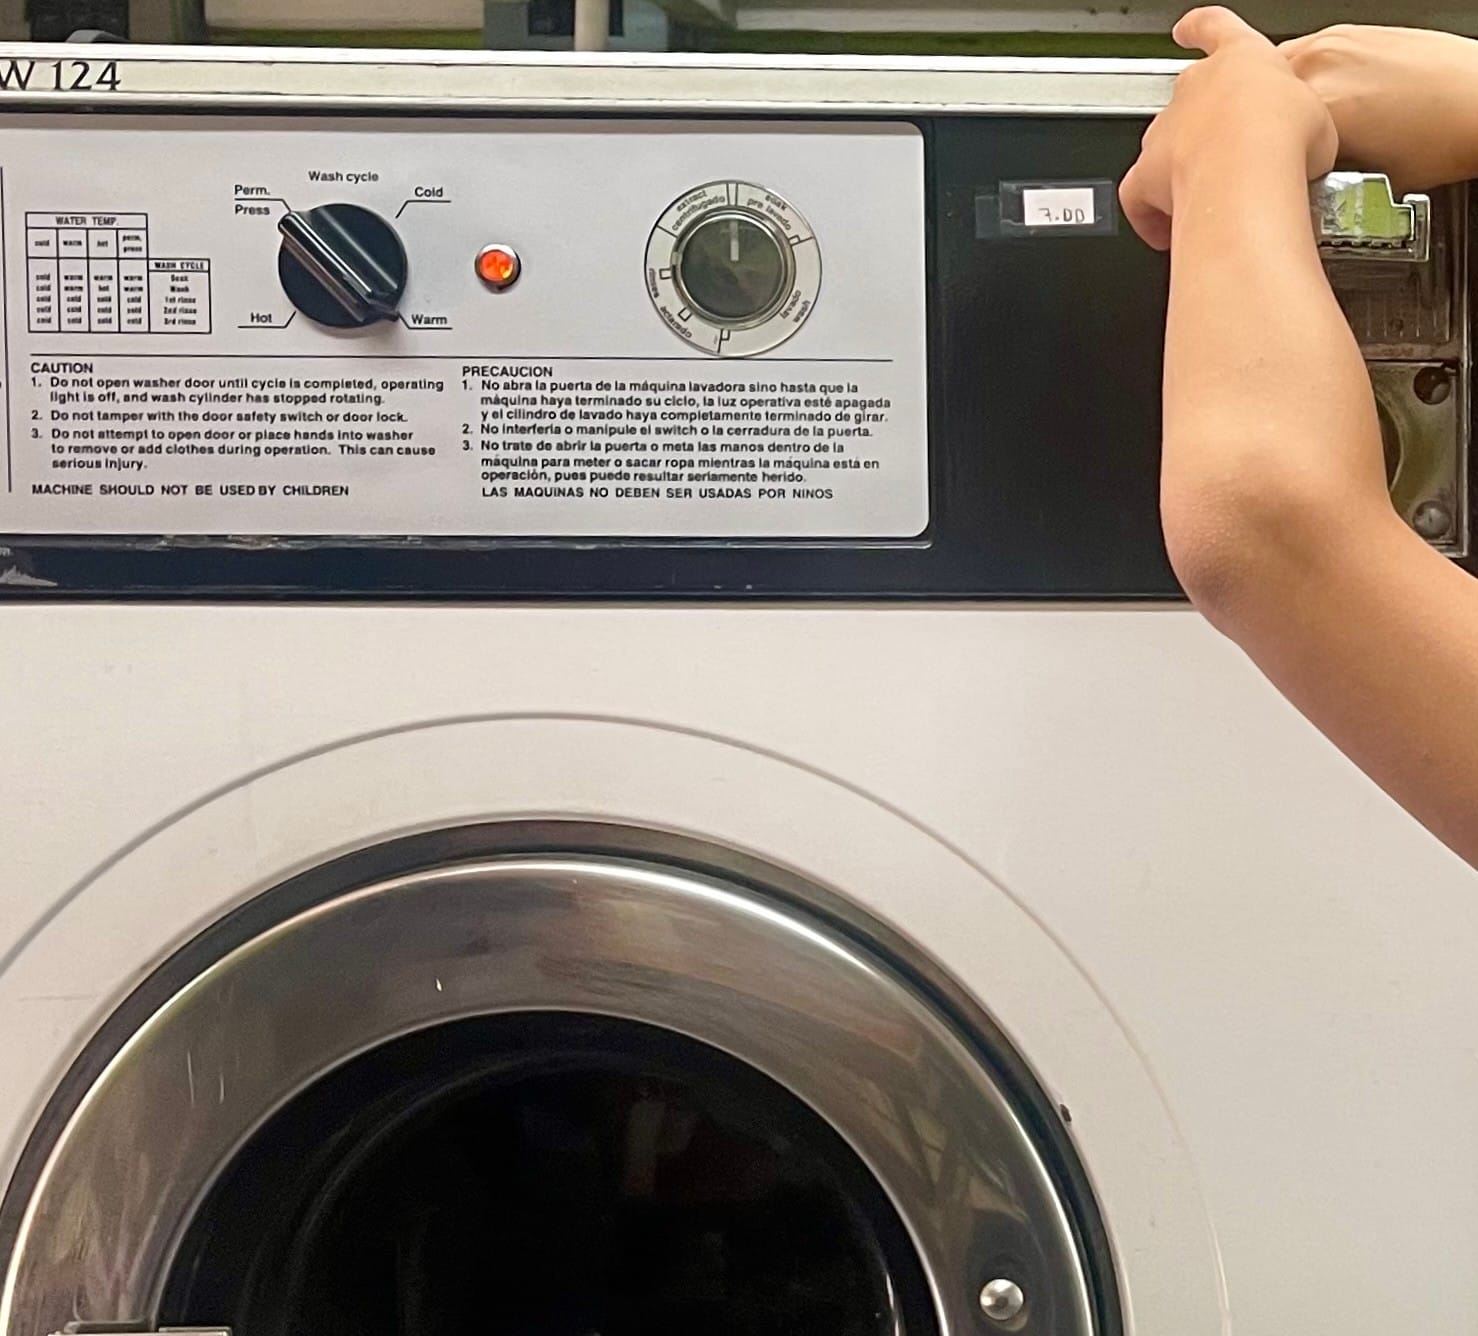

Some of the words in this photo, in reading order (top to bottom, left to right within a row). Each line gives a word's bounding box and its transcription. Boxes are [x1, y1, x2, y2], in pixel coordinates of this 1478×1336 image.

[308, 170, 343, 181] Wash
[345, 171, 379, 184] cycle
[234, 184, 271, 196] Perm.
[414, 186, 444, 197] Cold
[234, 204, 270, 215] Press
[250, 312, 273, 323] Hot
[411, 314, 448, 325] Warm
[30, 361, 93, 374] CAUTION
[462, 365, 552, 377] PRECAUCION
[31, 376, 42, 387] 1.
[50, 376, 69, 387] Do
[71, 376, 93, 387] not
[96, 378, 130, 390] open
[133, 377, 181, 388] washer
[184, 377, 215, 388] door
[218, 377, 248, 388] until
[251, 377, 286, 391] cycle
[289, 377, 301, 388] is
[303, 378, 377, 392] completed,
[381, 378, 444, 392] operating
[461, 379, 472, 390] 1.
[481, 379, 500, 391] No
[502, 379, 532, 391] abra
[535, 379, 546, 390] la
[549, 380, 592, 394] puerta
[595, 380, 611, 391] de
[614, 380, 626, 391] la
[688, 381, 745, 392] lavadora
[748, 381, 777, 392] sino
[780, 382, 816, 393] hasta
[819, 384, 844, 395] que
[846, 382, 858, 393] la
[50, 391, 79, 404] light
[83, 391, 94, 402] is
[97, 391, 120, 403] off,
[123, 391, 147, 402] and
[151, 391, 185, 402] wash
[188, 392, 242, 405] cylinder
[245, 392, 269, 403] has
[273, 392, 326, 405] stopped
[329, 393, 384, 406] rotating.
[31, 409, 42, 420] 2.
[50, 409, 69, 421] Do
[72, 410, 94, 421] not
[96, 410, 144, 423] tamper
[146, 410, 175, 421] with
[178, 410, 199, 421] the
[201, 410, 233, 421] door
[236, 410, 276, 424] safety
[280, 410, 323, 422] switch
[326, 413, 340, 422] or
[342, 411, 373, 422] door
[376, 411, 408, 422] lock.
[31, 427, 42, 439] 3.
[51, 427, 70, 439] Do
[72, 429, 94, 439] not
[97, 428, 148, 441] attempt
[151, 429, 165, 439] to
[167, 431, 201, 442] open
[204, 429, 235, 440] door
[238, 431, 252, 440] or
[255, 429, 291, 442] place
[293, 429, 334, 440] hands
[337, 429, 363, 440] into
[366, 429, 413, 440] washer
[51, 443, 64, 454] to
[67, 445, 117, 454] remove
[120, 445, 135, 454] or
[137, 443, 162, 454] add
[165, 443, 214, 455] clothes
[217, 443, 261, 457] during
[263, 444, 331, 457] operation.
[338, 444, 366, 455] This
[369, 446, 393, 455] can
[396, 446, 435, 456] cause
[52, 457, 102, 468] serious
[104, 457, 147, 471] injury.
[31, 483, 92, 495] MACHINE
[99, 484, 154, 495] SHOULD
[160, 484, 188, 495] NOT
[195, 484, 212, 495] BE
[219, 484, 255, 496] USED
[258, 485, 276, 496] BY
[282, 485, 348, 496] CHILDREN
[482, 486, 508, 497] LAS
[514, 486, 584, 497] MAQUINAS
[589, 486, 608, 497] NO
[615, 487, 660, 498] DEBEN
[666, 487, 692, 498] SER
[698, 487, 751, 498] USADAS
[758, 488, 786, 498] POR
[792, 488, 833, 499] NINOS
